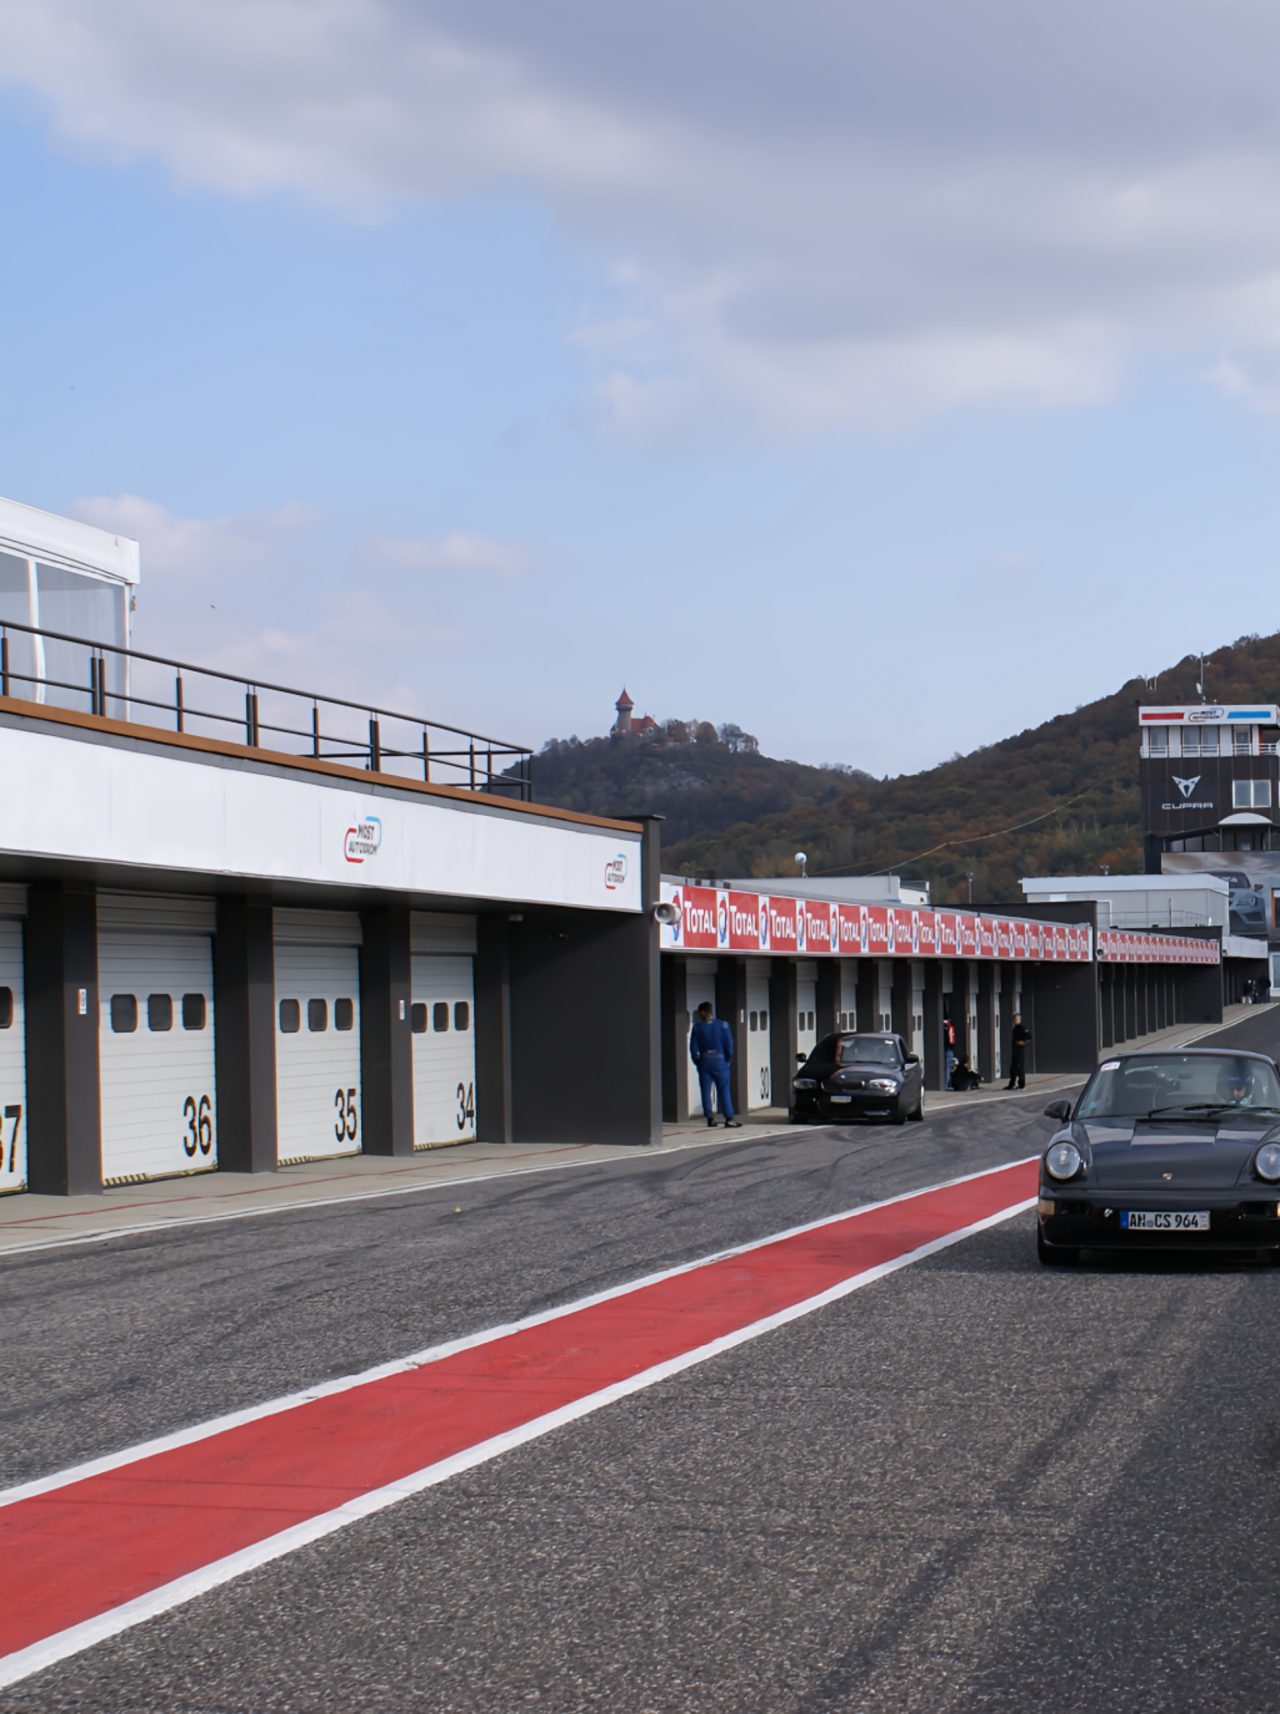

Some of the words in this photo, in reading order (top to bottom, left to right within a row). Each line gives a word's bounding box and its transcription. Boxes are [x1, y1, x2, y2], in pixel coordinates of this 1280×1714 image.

[1161, 802, 1213, 810] CUPRA
[357, 823, 375, 840] MOST
[349, 840, 378, 855] AUTODROM
[684, 901, 716, 934] TOTAL
[730, 905, 758, 937] TOTAL
[770, 909, 796, 939] TOTAL
[806, 912, 829, 939] TOTAL
[840, 915, 861, 942] TOTAL
[335, 1088, 357, 1142] 35
[456, 1082, 474, 1130] 34
[183, 1094, 212, 1157] 36
[1154, 1214, 1171, 1228] CS
[1174, 1214, 1198, 1228] 964
